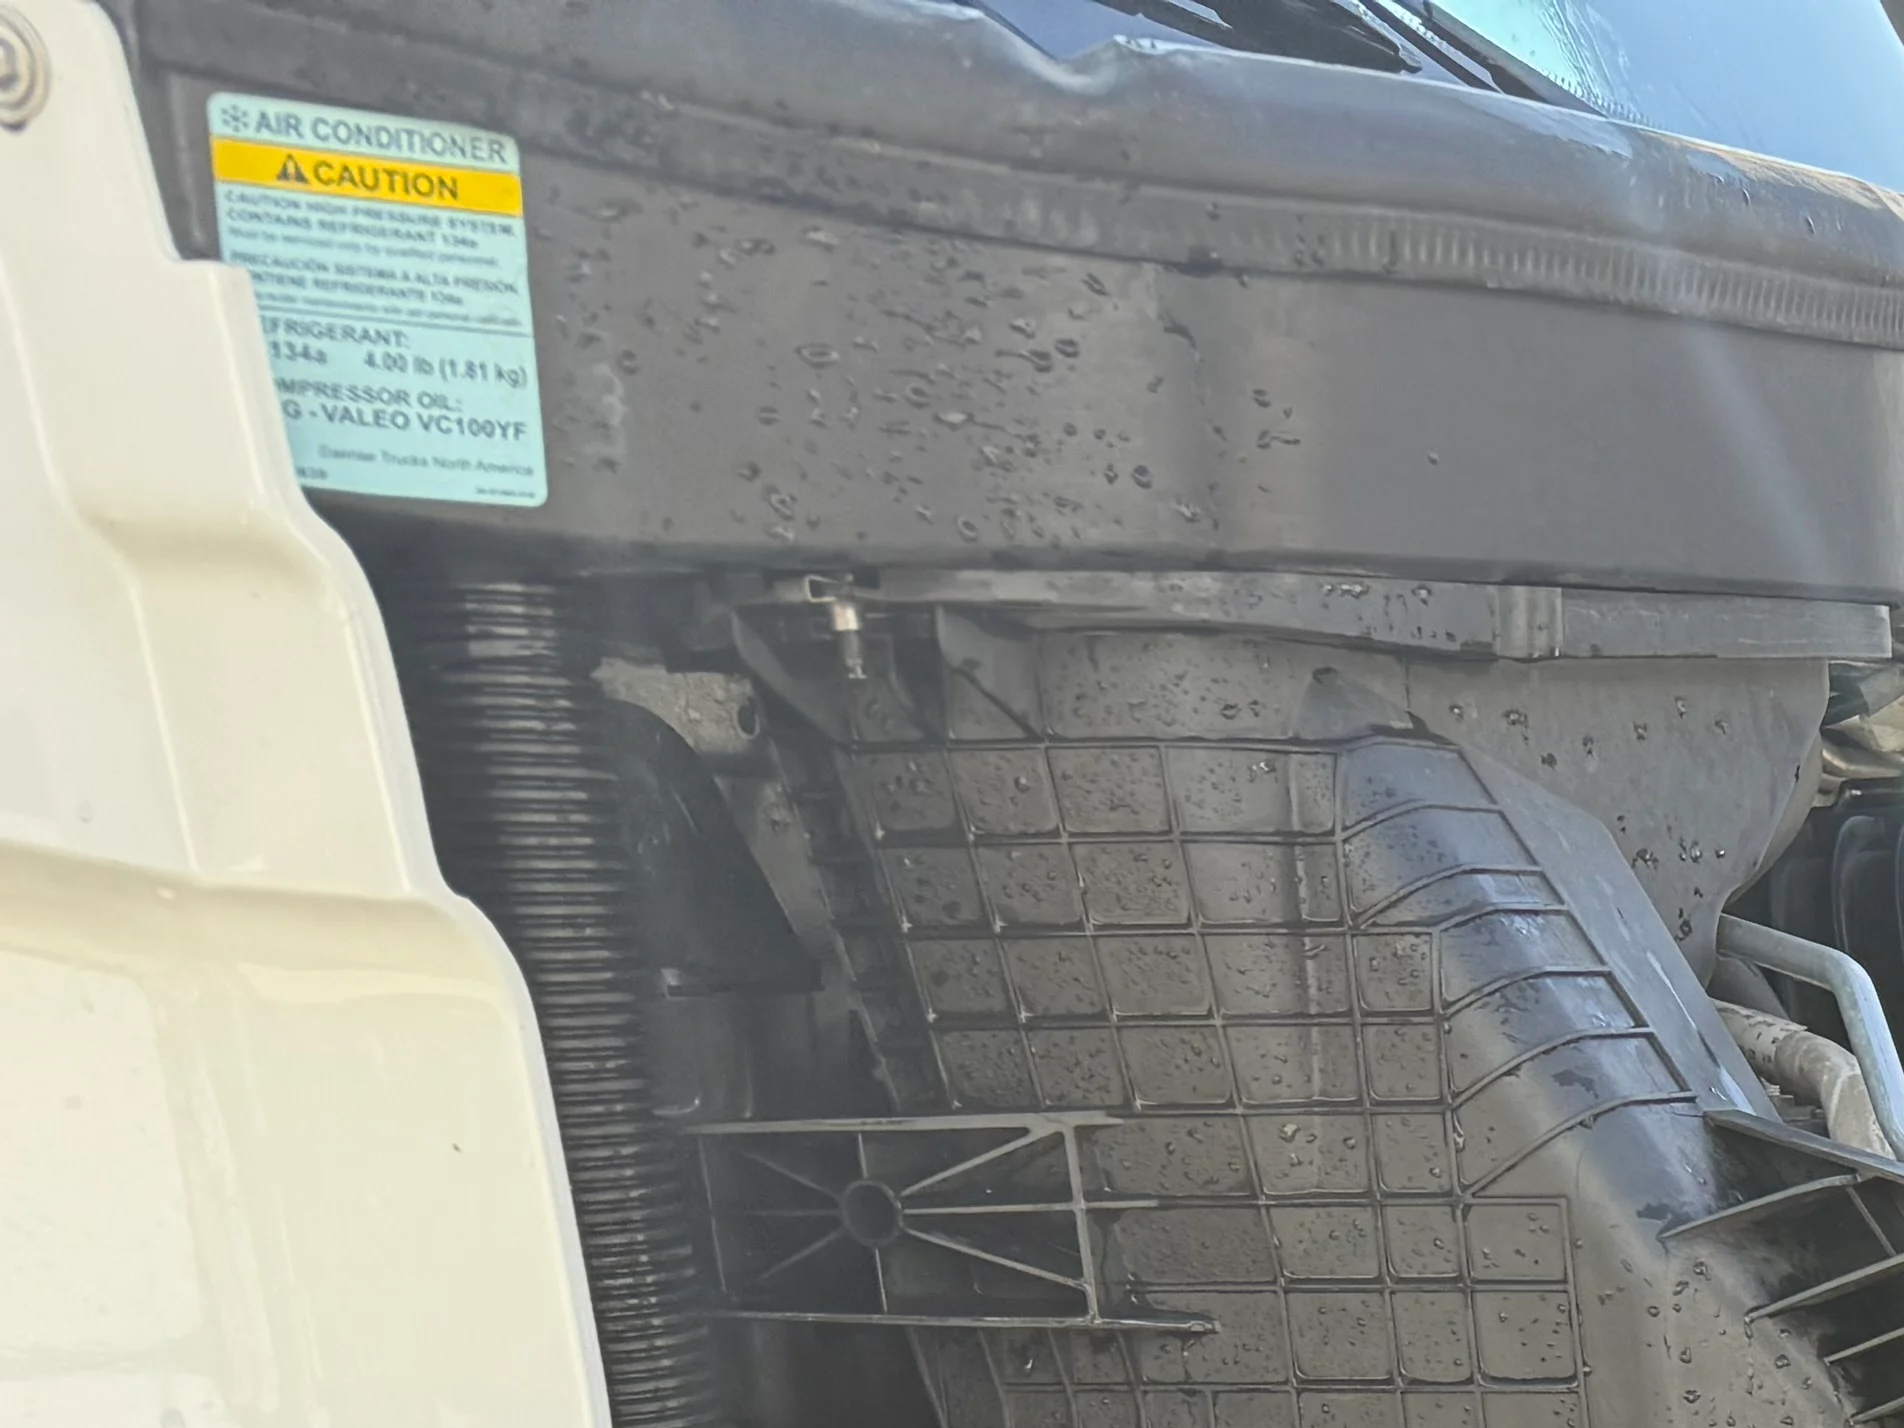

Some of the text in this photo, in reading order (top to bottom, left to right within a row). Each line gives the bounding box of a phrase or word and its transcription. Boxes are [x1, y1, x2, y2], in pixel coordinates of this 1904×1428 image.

[255, 111, 507, 164] AIR CONDITIONER
[313, 160, 459, 201] CAUTION
[365, 350, 408, 373] 4.00
[321, 403, 410, 431] VALEO
[416, 412, 527, 441] VC100YF
